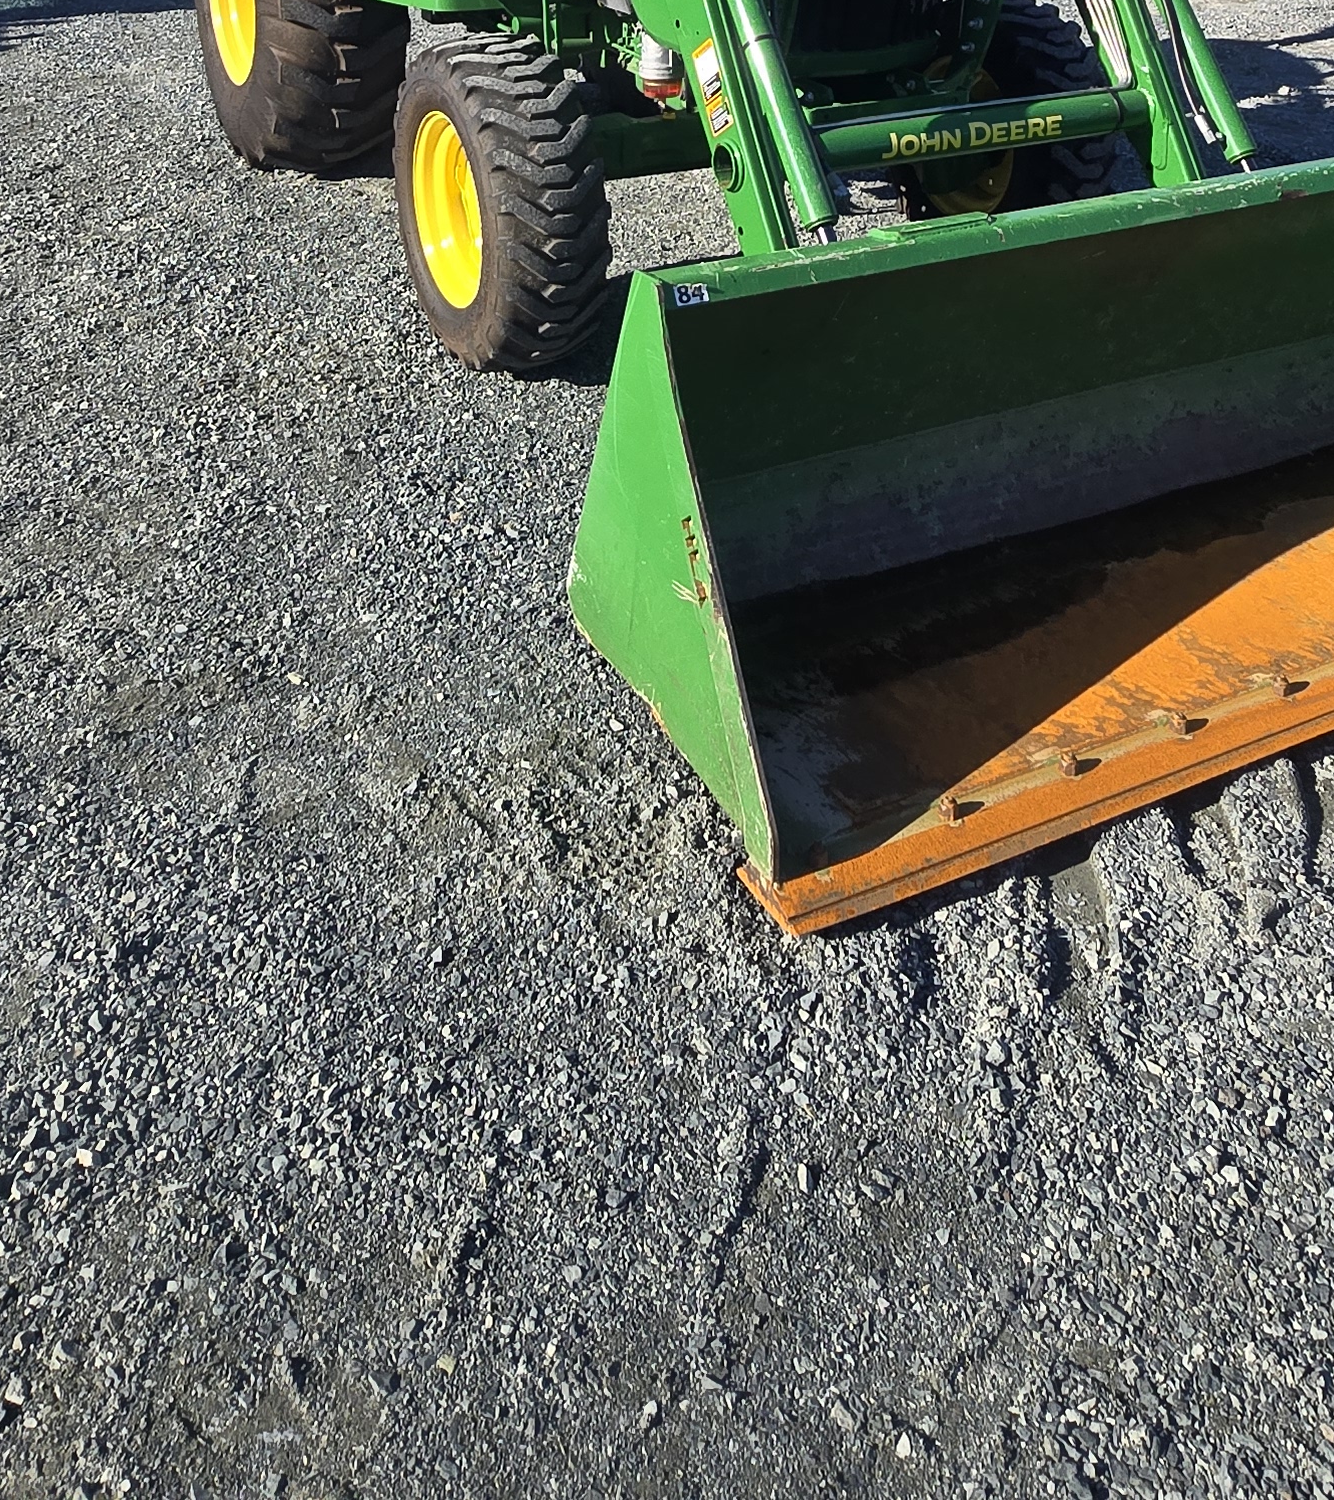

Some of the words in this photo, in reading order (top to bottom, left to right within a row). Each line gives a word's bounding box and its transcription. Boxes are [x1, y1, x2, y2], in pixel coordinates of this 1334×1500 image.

[881, 128, 962, 160] JOHN
[968, 114, 1064, 148] DEERE
[676, 284, 706, 304] 84
